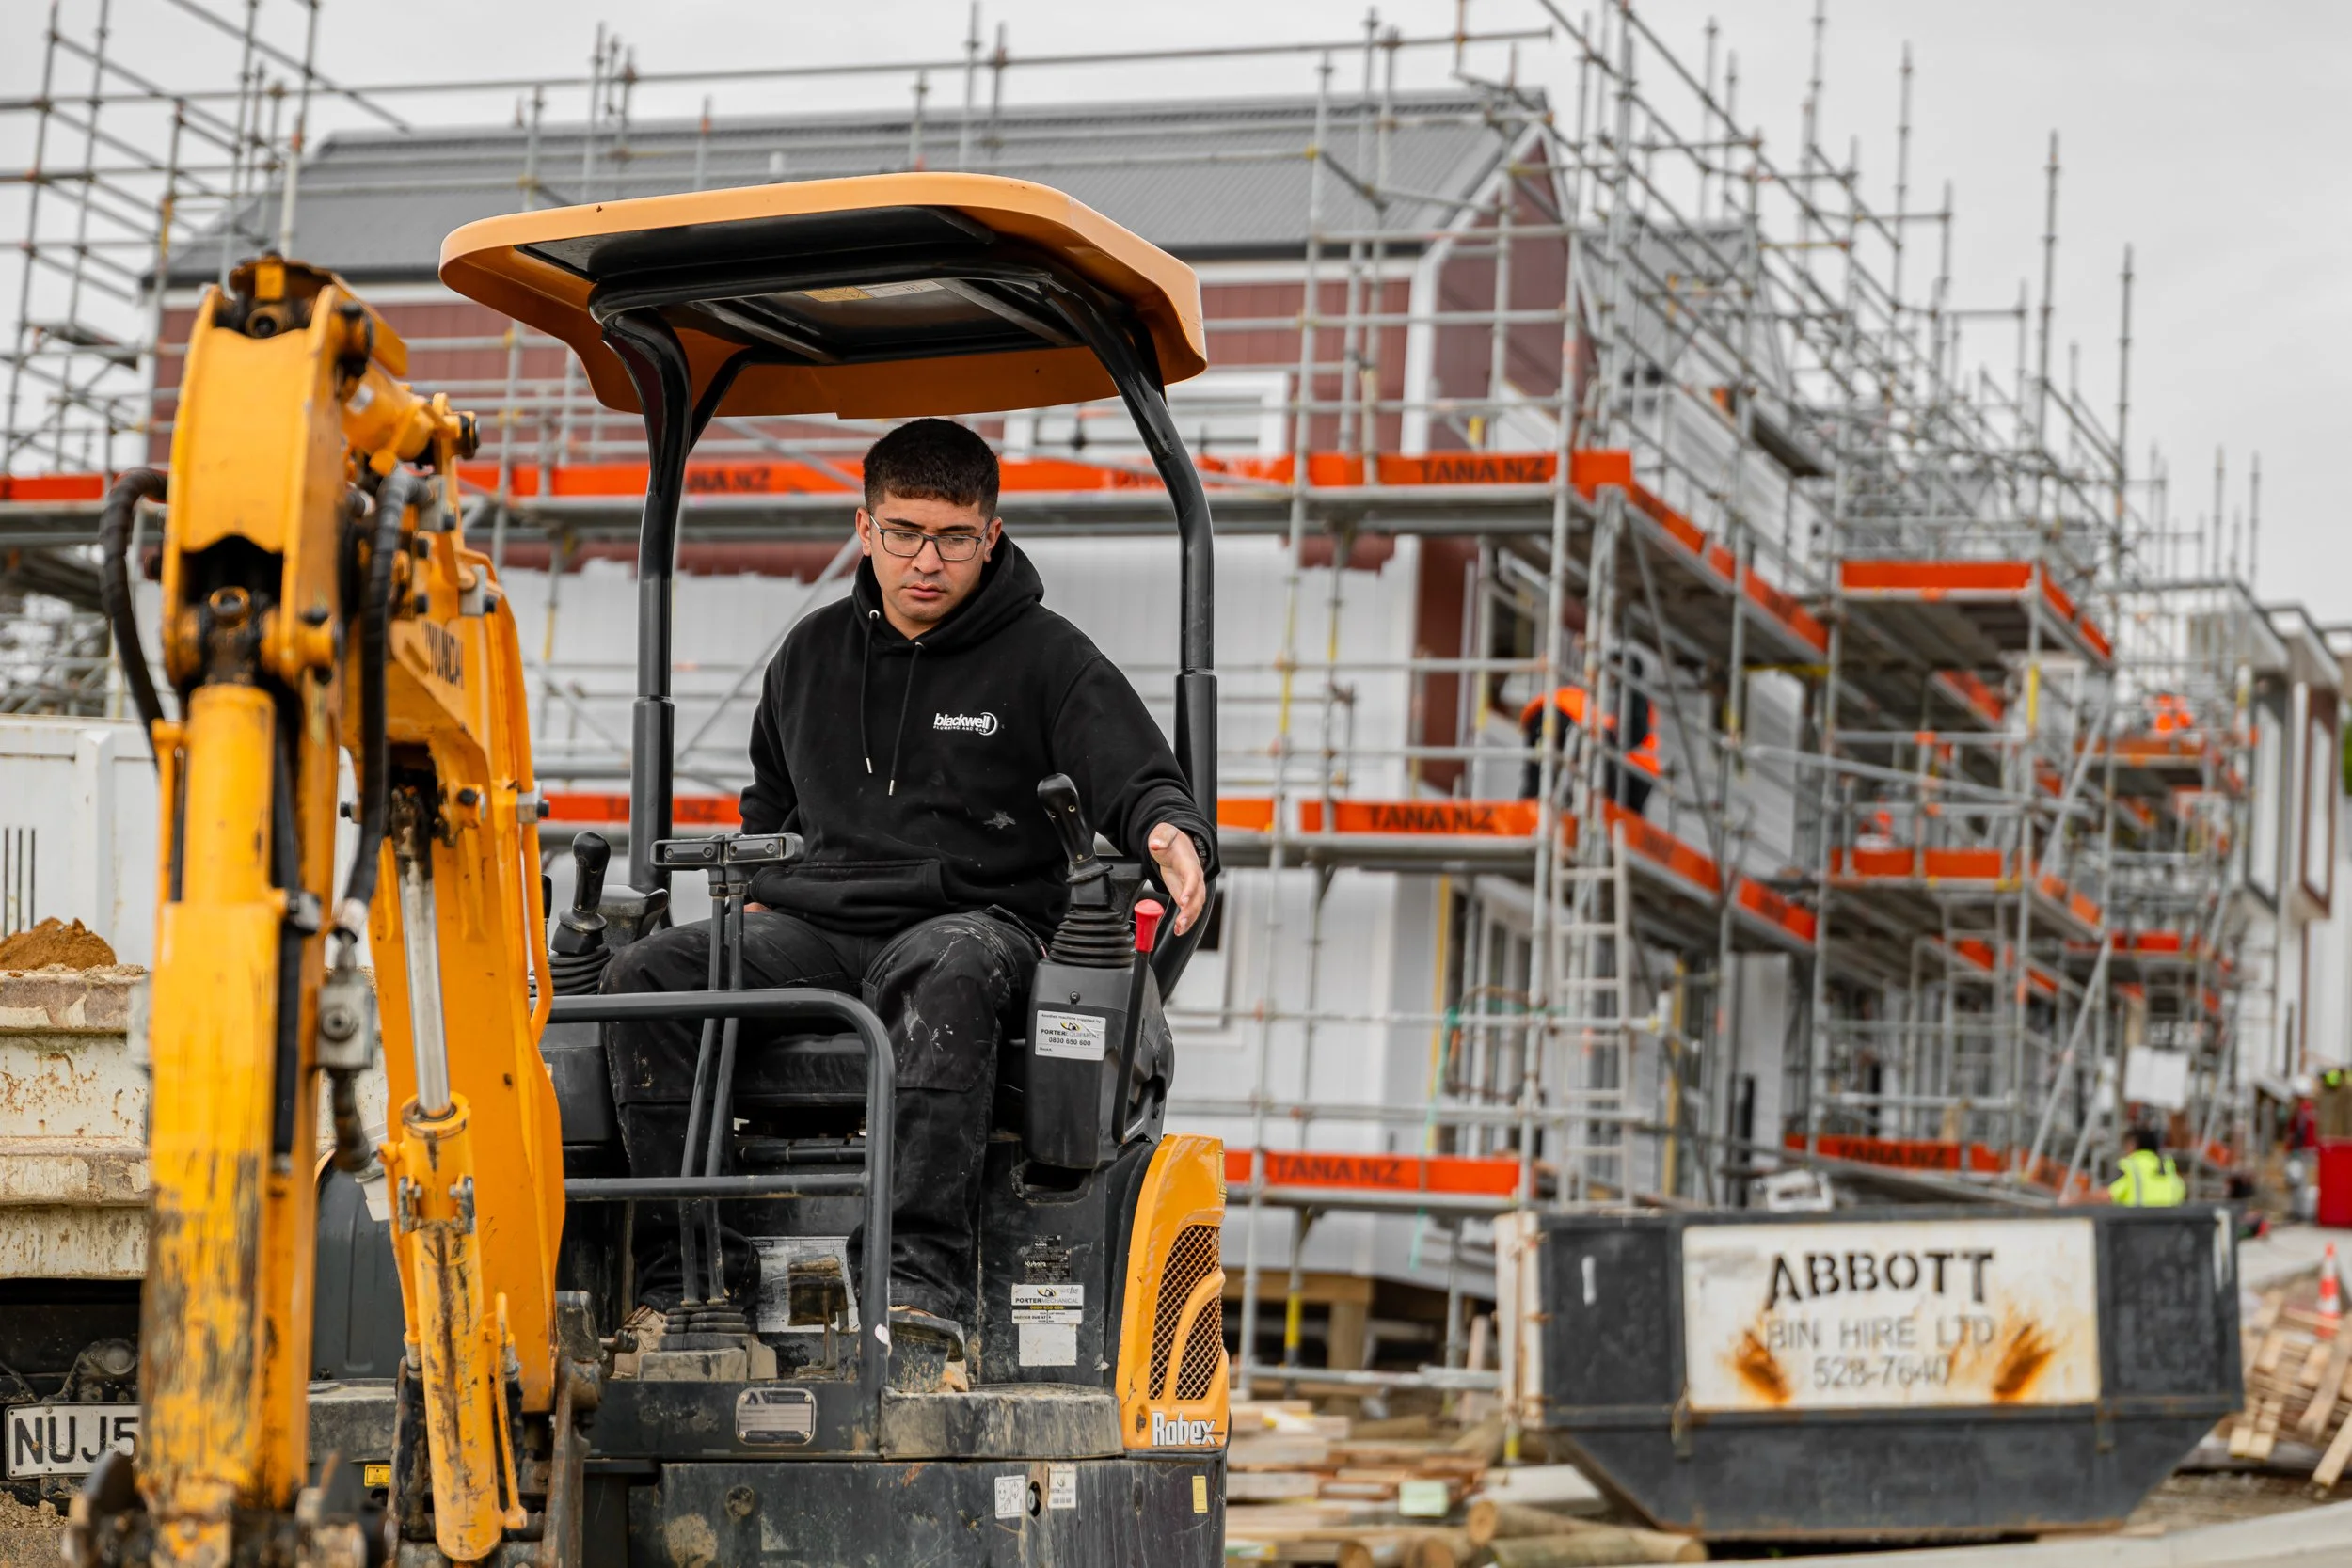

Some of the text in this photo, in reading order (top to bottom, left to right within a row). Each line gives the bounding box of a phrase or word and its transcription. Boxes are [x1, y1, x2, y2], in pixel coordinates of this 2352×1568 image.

[1419, 459, 1546, 483] TANA NZ
[934, 713, 991, 730] blackwell
[1369, 805, 1496, 832] TANA NZ
[1274, 1155, 1402, 1184] TANA NZ
[1763, 1249, 1995, 1311] ABBOTT
[1766, 1314, 1995, 1351] BIN HIRE LTD
[1813, 1354, 1951, 1389] 528-7640
[14, 1415, 140, 1466] NUJ5
[1151, 1410, 1216, 1447] Robex
